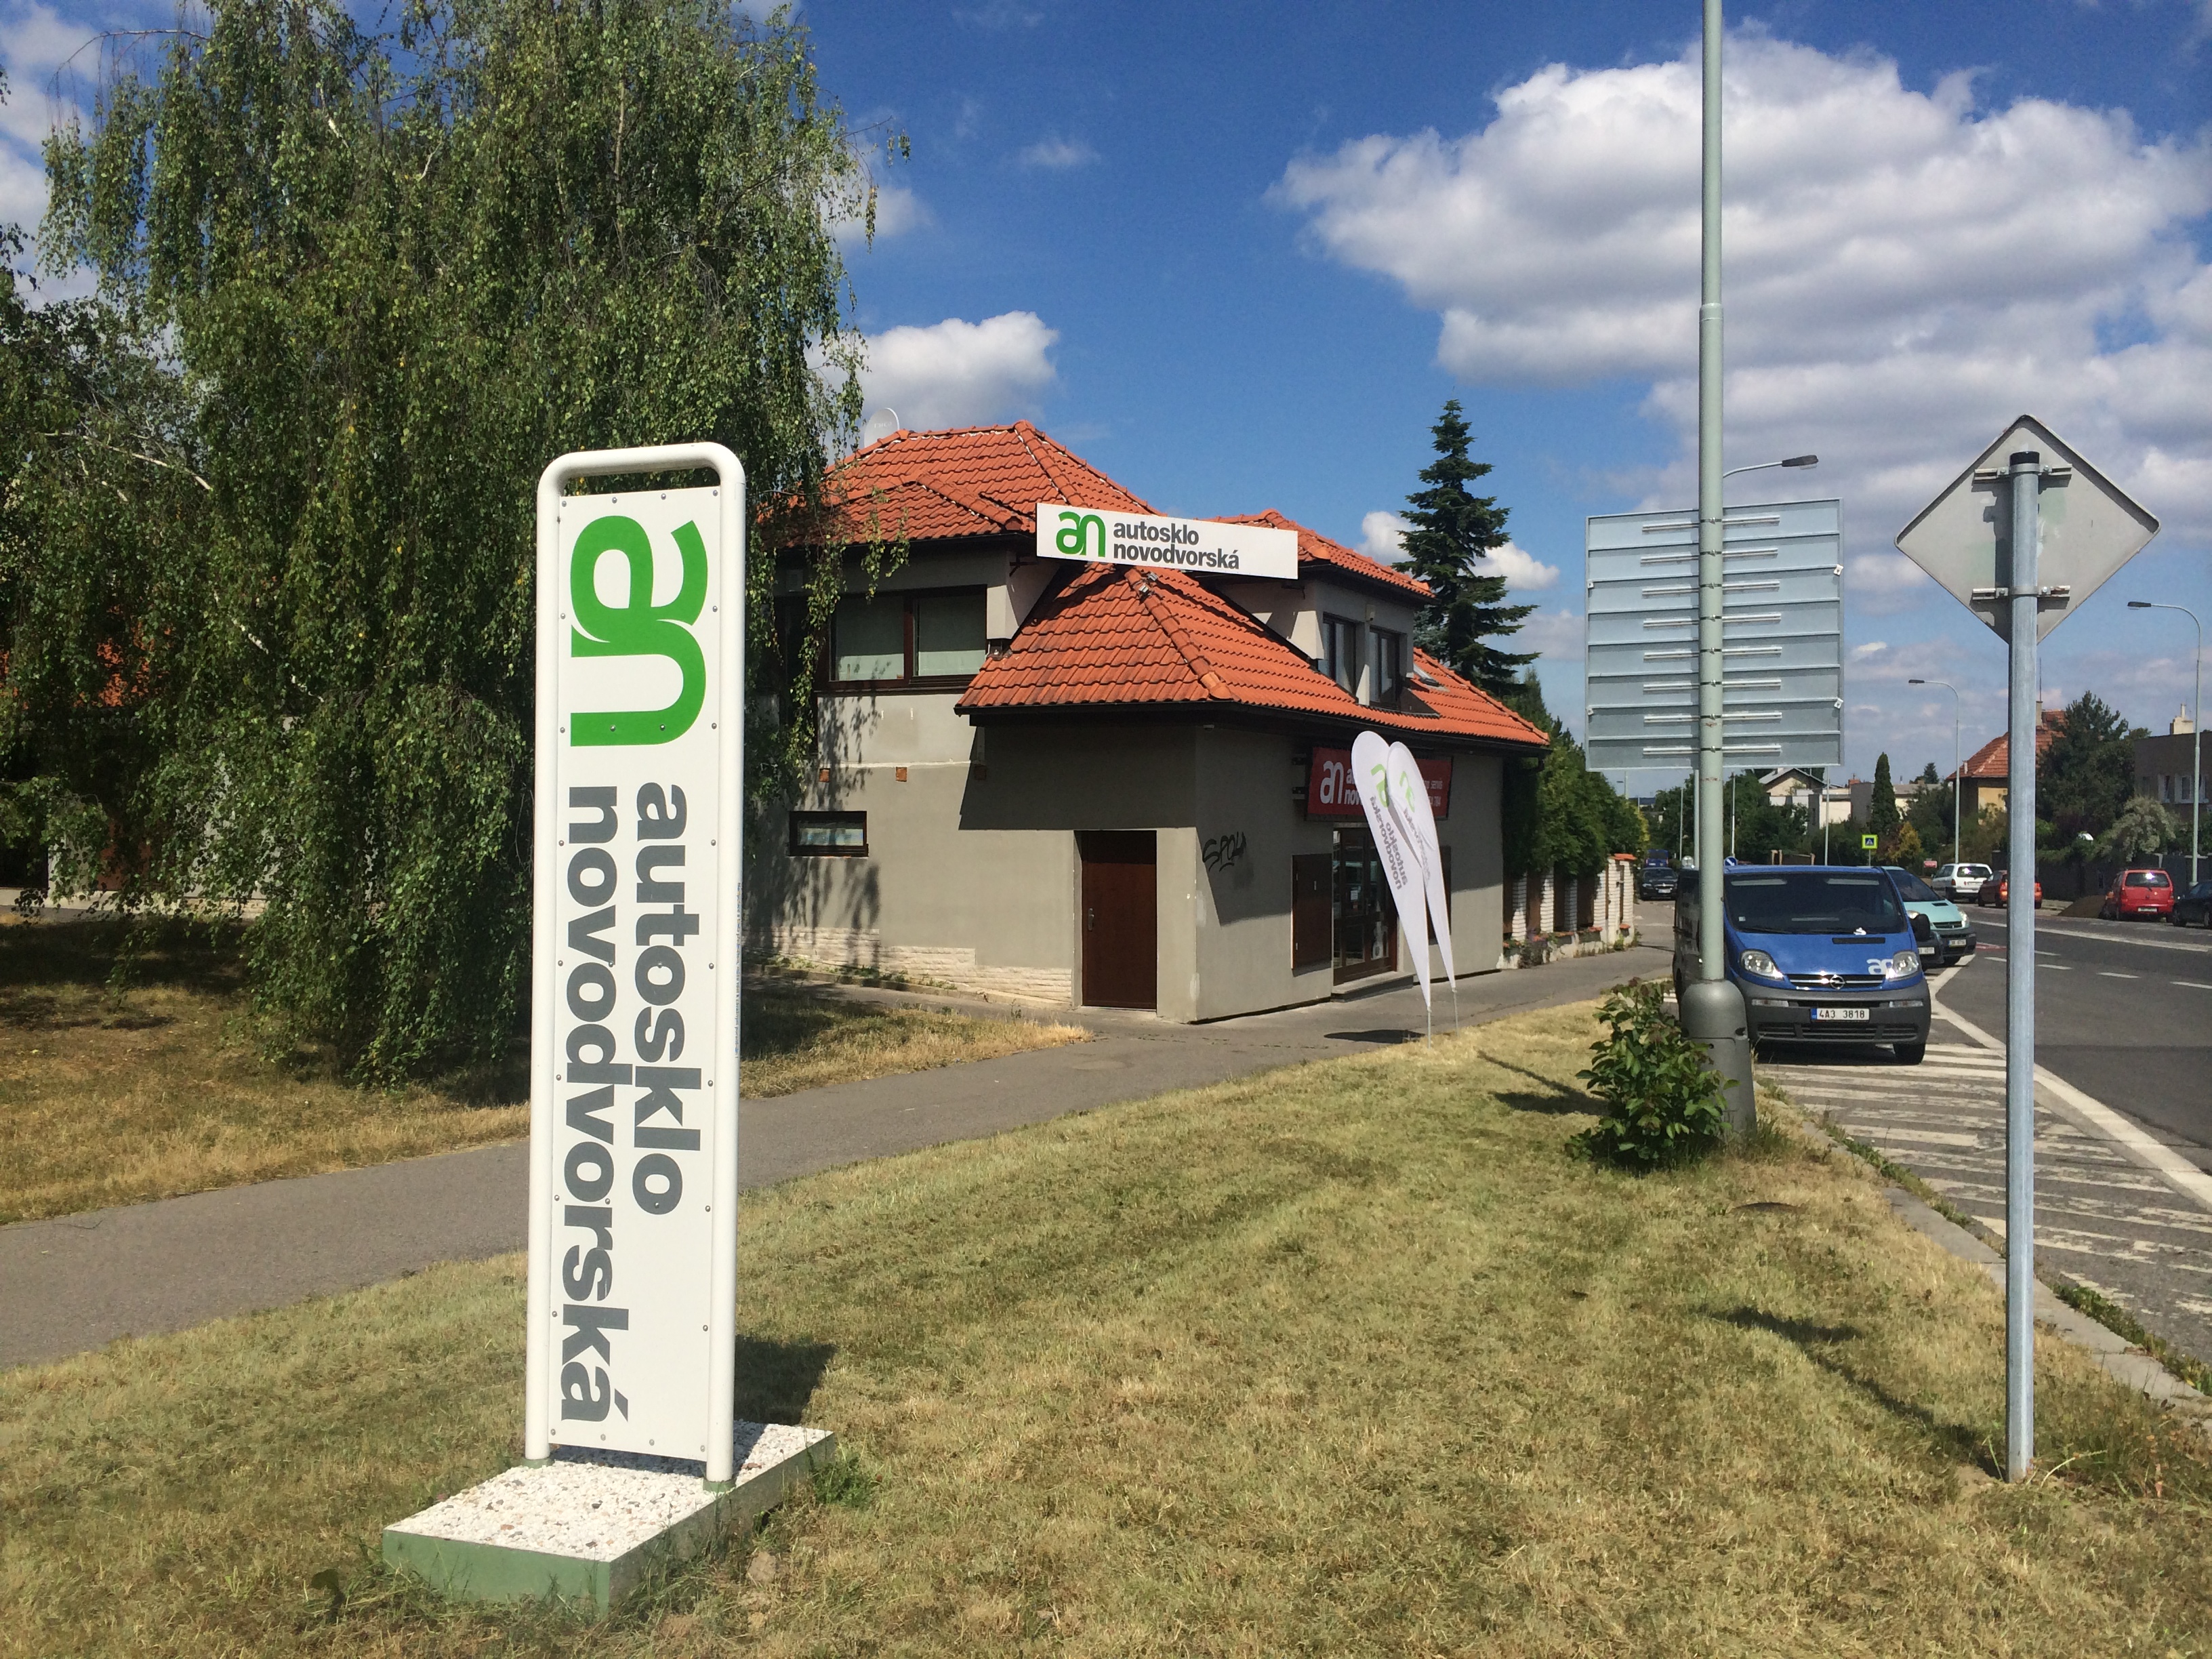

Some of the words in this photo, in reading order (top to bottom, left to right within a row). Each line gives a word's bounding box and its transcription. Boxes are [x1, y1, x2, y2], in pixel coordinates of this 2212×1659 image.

[1056, 512, 1106, 557] an
[1113, 522, 1200, 546] autosklo
[1113, 544, 1240, 569] novodvorská
[571, 516, 708, 747] an
[634, 782, 701, 1215] autosklo
[1819, 1009, 1836, 1019] 4A3
[1843, 1009, 1865, 1019] 3818
[561, 786, 633, 1422] novodvorská
